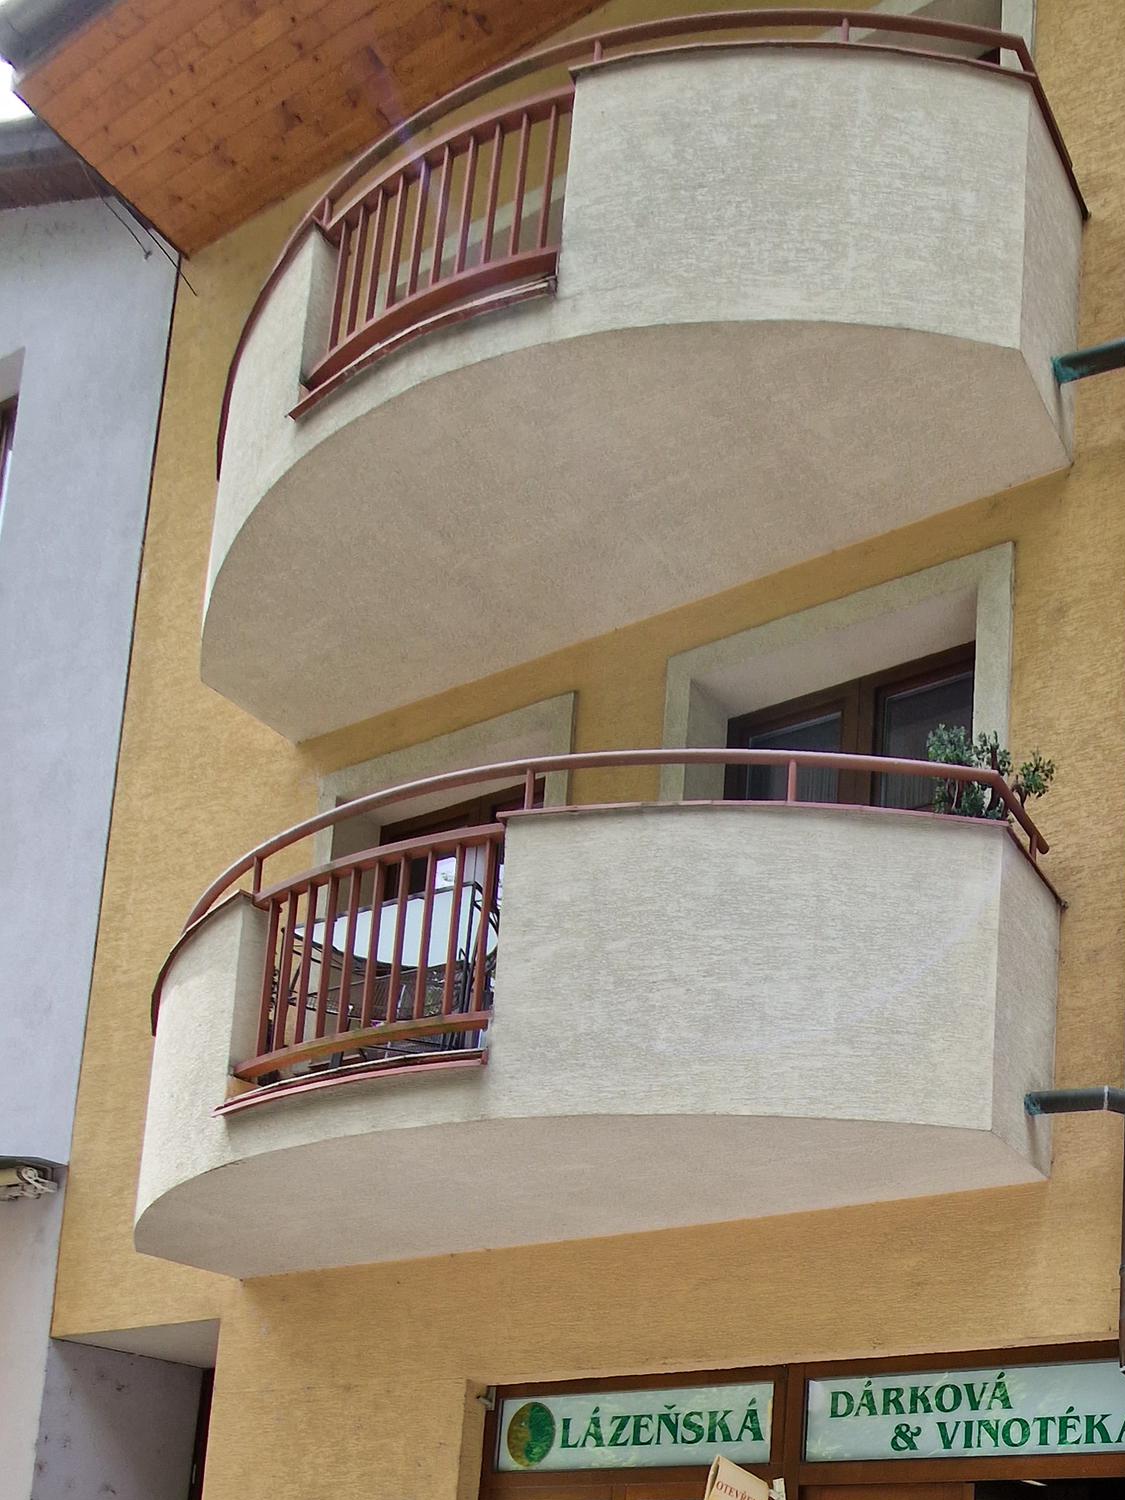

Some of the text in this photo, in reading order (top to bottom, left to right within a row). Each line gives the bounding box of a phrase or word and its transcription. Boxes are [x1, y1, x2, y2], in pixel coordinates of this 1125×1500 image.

[829, 1372, 1013, 1418] DÁRKOVÁ
[559, 1397, 765, 1449] LÁZEŇSKÁ
[890, 1422, 922, 1450] &
